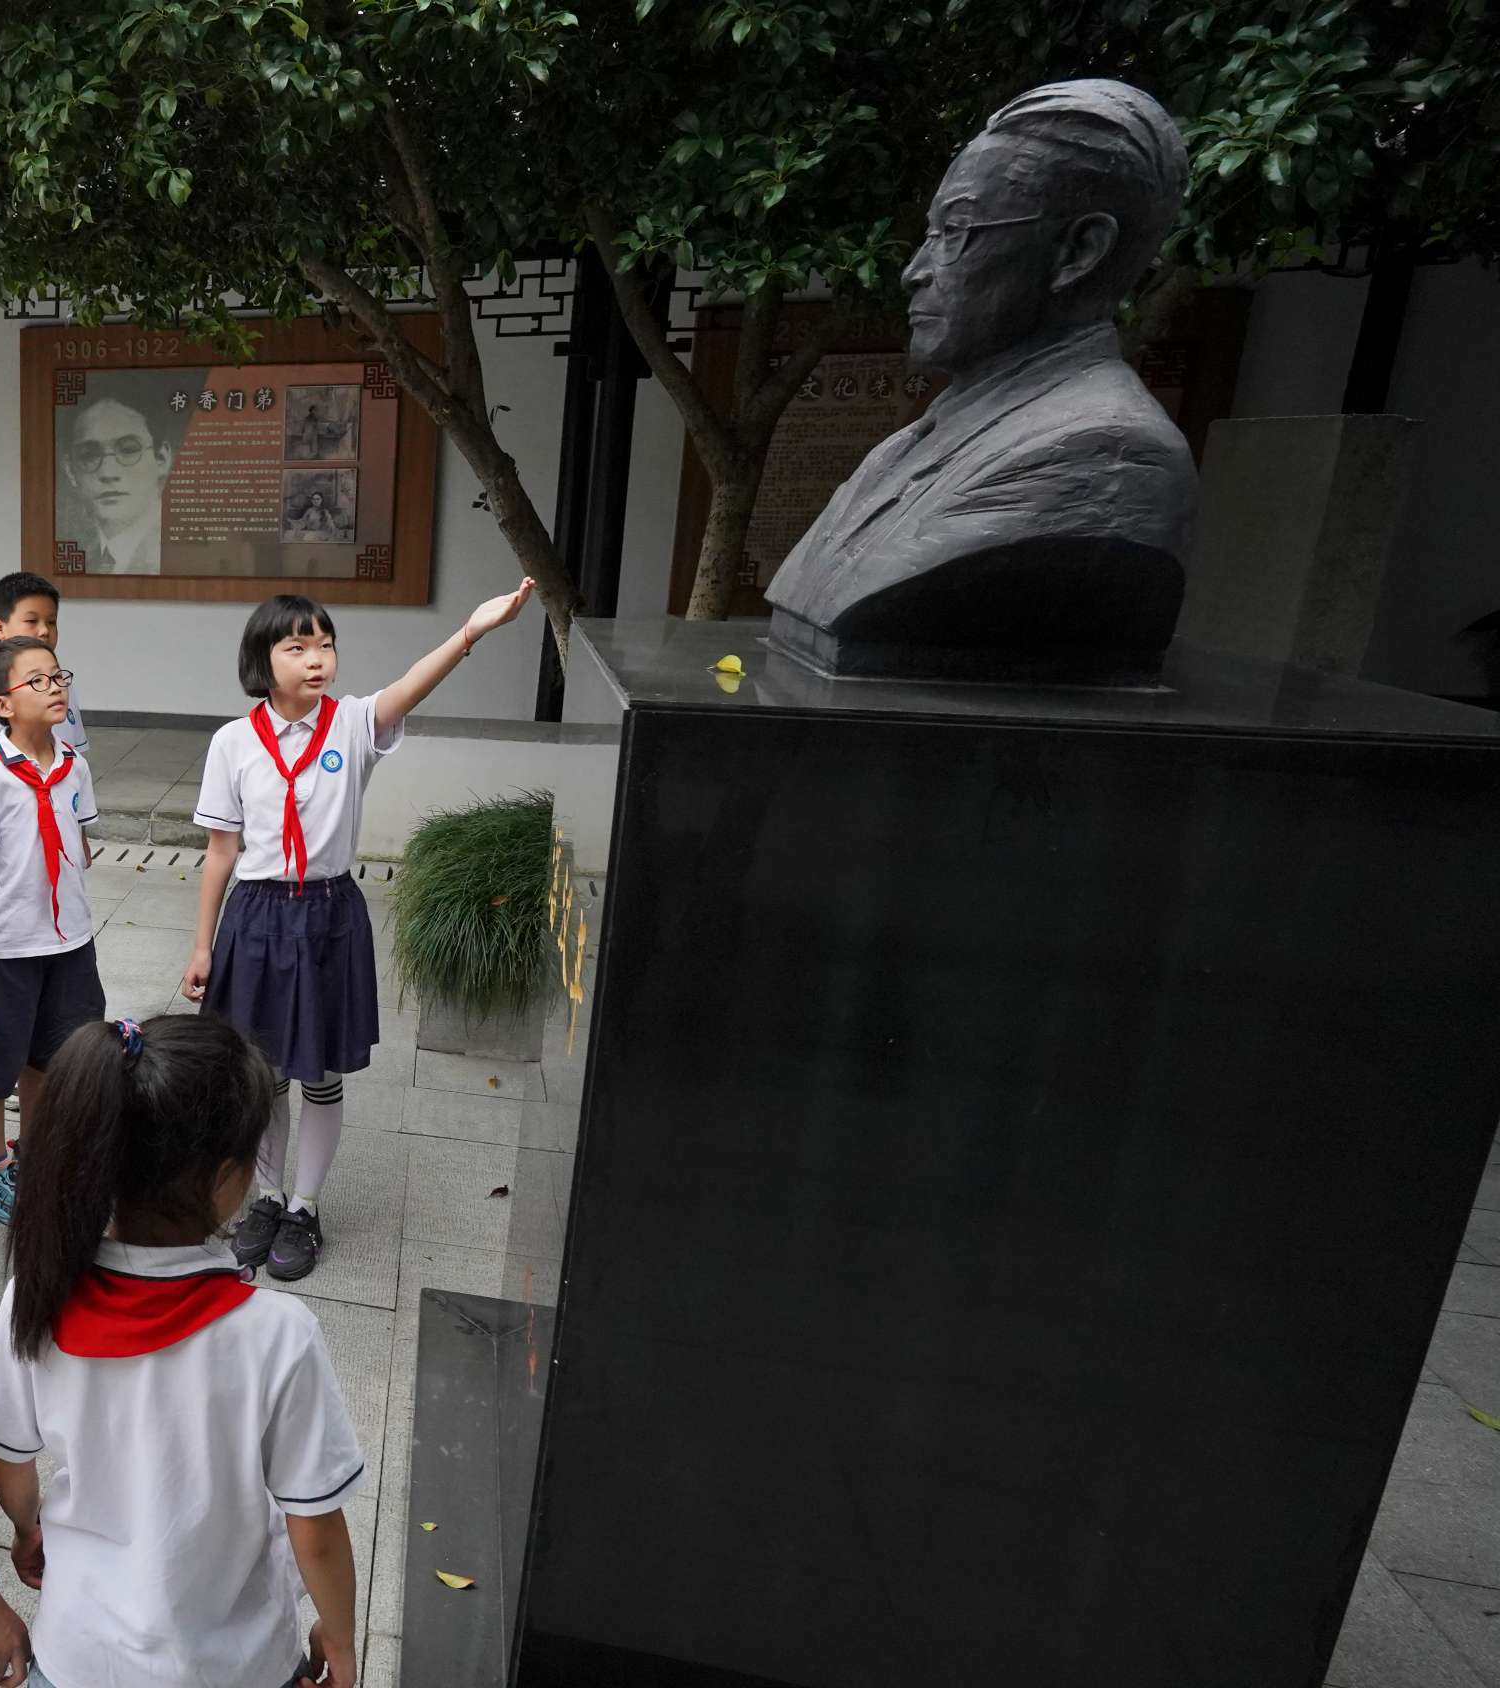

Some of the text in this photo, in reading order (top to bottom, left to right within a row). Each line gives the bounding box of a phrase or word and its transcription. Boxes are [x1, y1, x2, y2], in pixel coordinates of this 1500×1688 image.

[53, 337, 181, 361] 1906-1922
[170, 388, 275, 412] 书香门第
